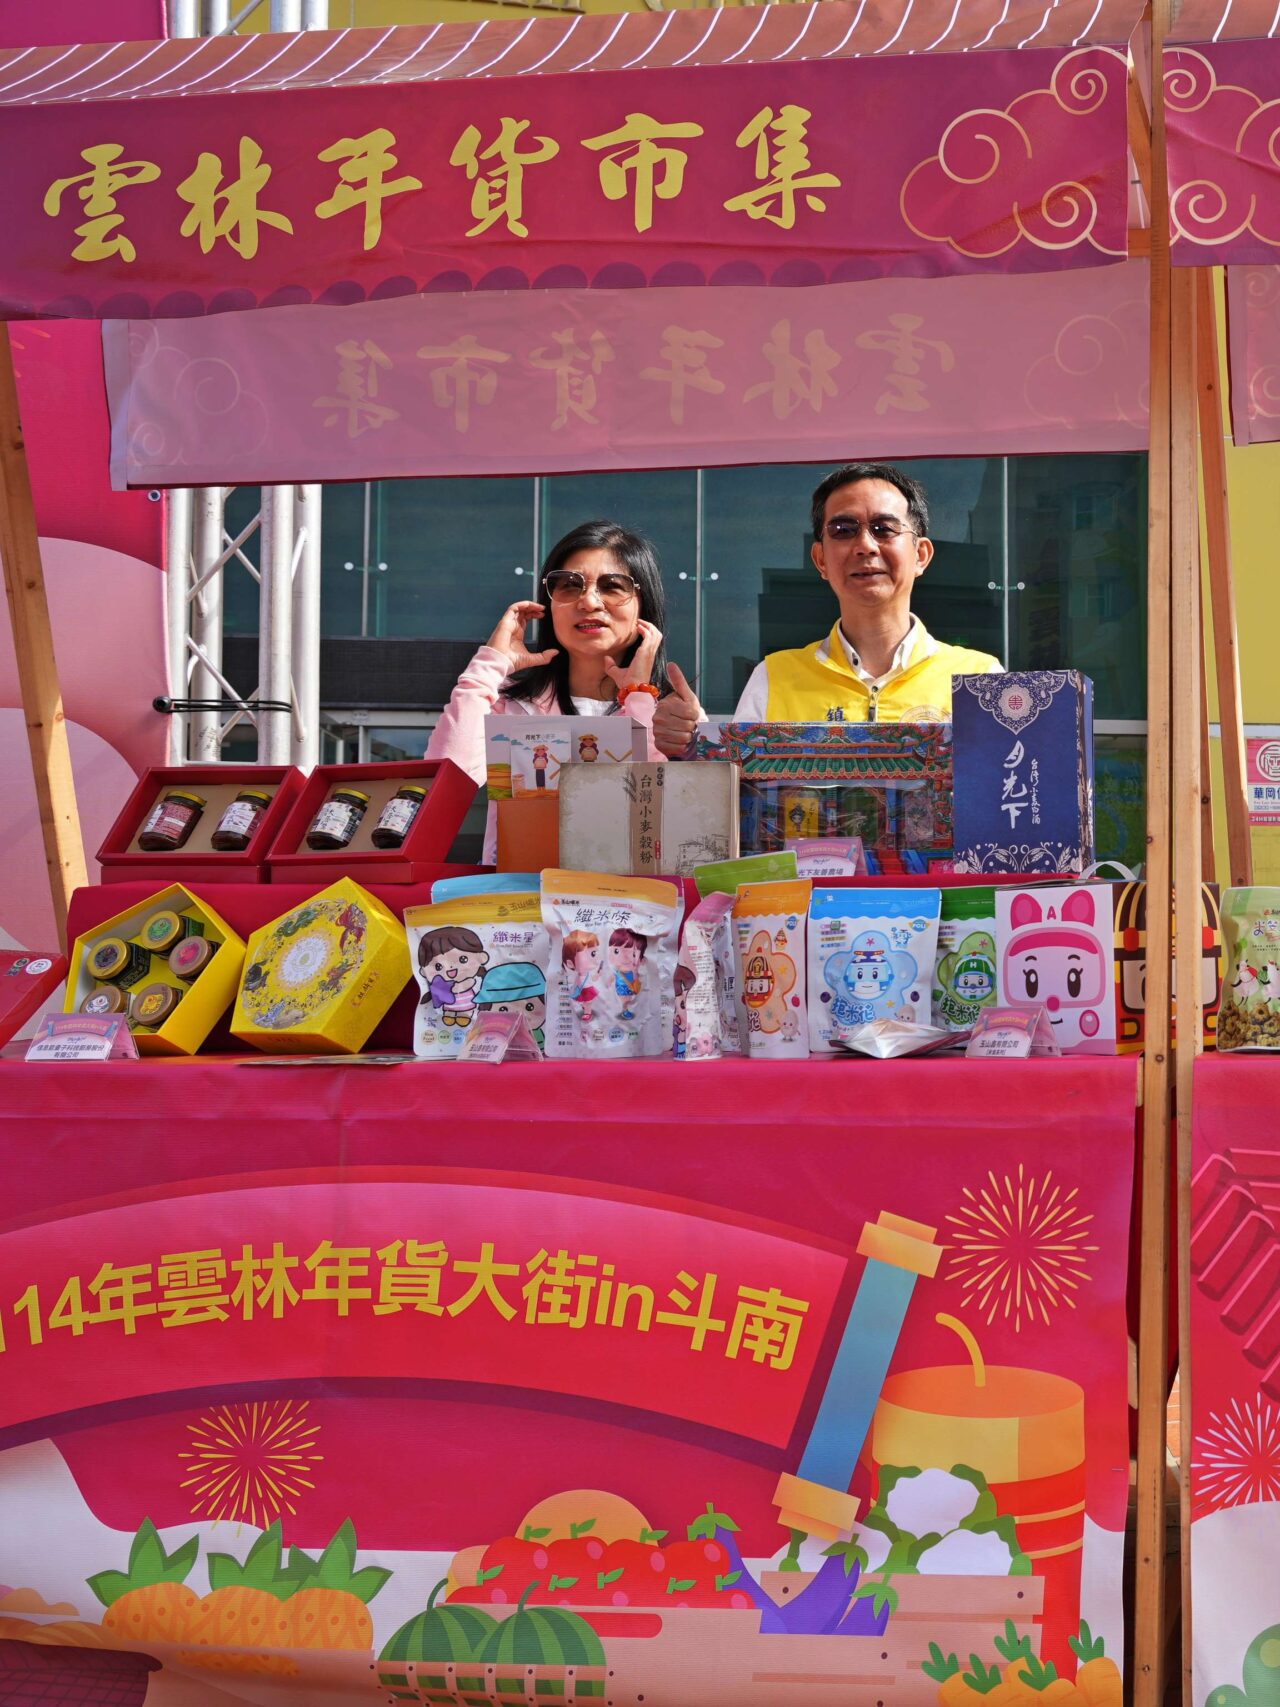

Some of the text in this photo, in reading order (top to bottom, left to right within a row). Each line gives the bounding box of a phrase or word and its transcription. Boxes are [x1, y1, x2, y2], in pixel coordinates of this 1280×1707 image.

[44, 105, 842, 263] 雲林年貨市集
[640, 774, 653, 864] 台灣小麥穀粉
[1001, 740, 1029, 830] 月光下
[1047, 906, 1057, 920] A
[970, 961, 977, 969] H
